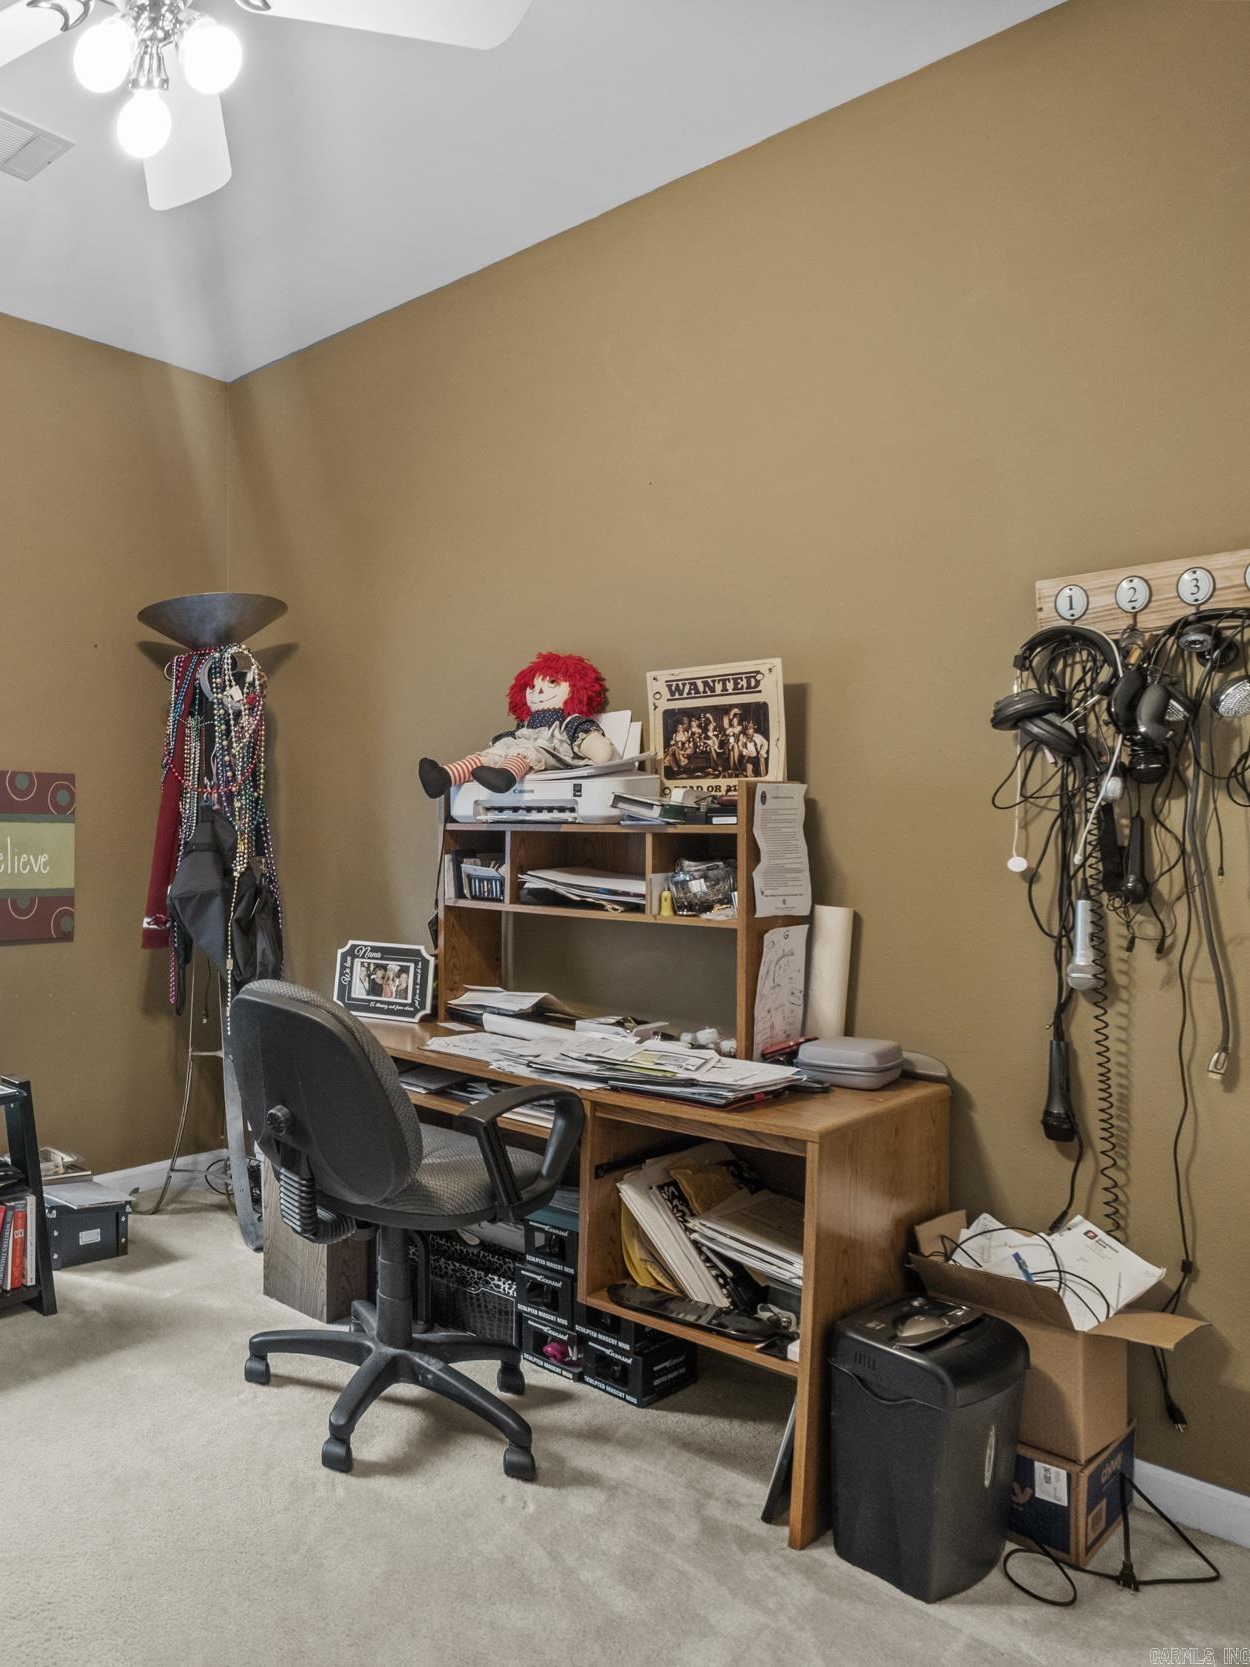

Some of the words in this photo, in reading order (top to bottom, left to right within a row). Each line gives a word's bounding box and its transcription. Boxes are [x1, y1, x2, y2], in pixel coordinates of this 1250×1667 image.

[1127, 587, 1138, 603] 2
[1190, 578, 1200, 595] 3
[1067, 594, 1075, 611] 1
[665, 675, 761, 697] WANTED
[355, 946, 382, 958] Nana
